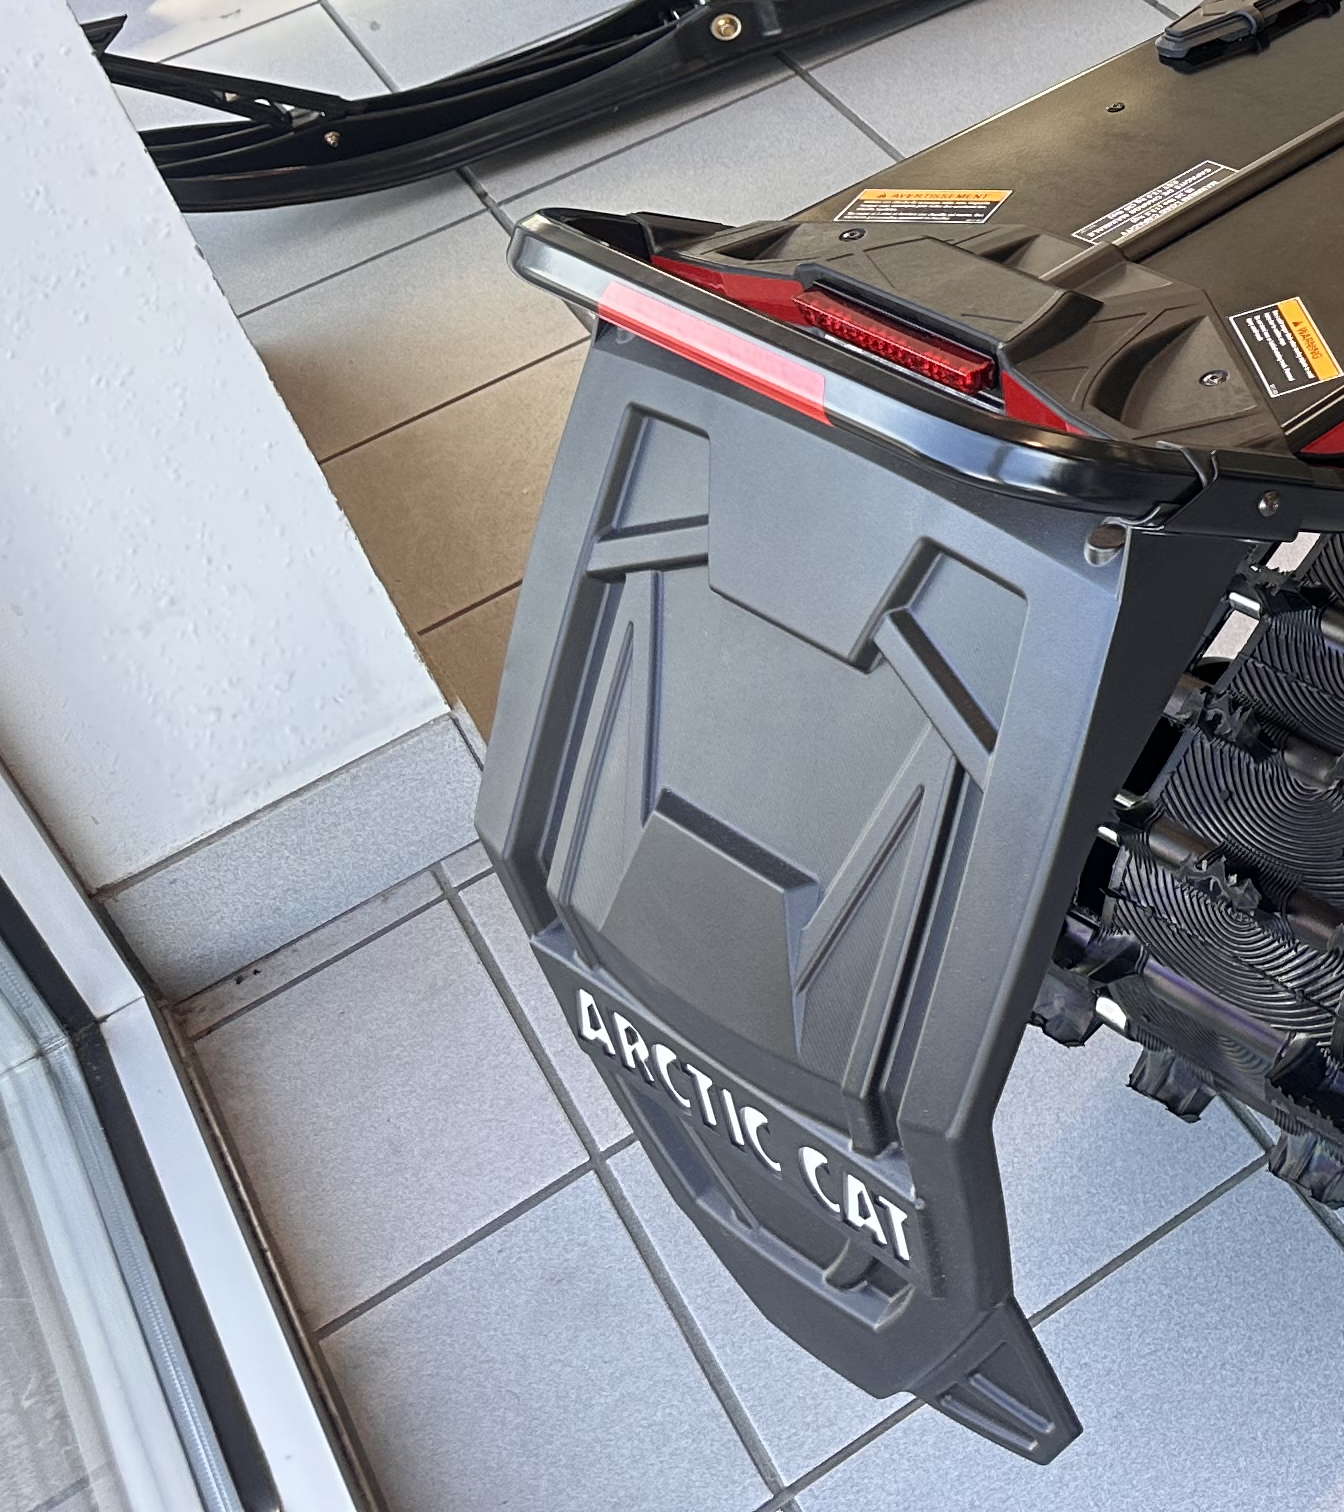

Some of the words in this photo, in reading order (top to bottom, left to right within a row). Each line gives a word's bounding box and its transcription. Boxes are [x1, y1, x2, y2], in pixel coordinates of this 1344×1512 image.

[892, 192, 991, 200] AVERTISSEMENT
[1297, 326, 1324, 360] WARNING
[578, 988, 784, 1172] ARCTIC
[799, 1145, 913, 1264] CAT
